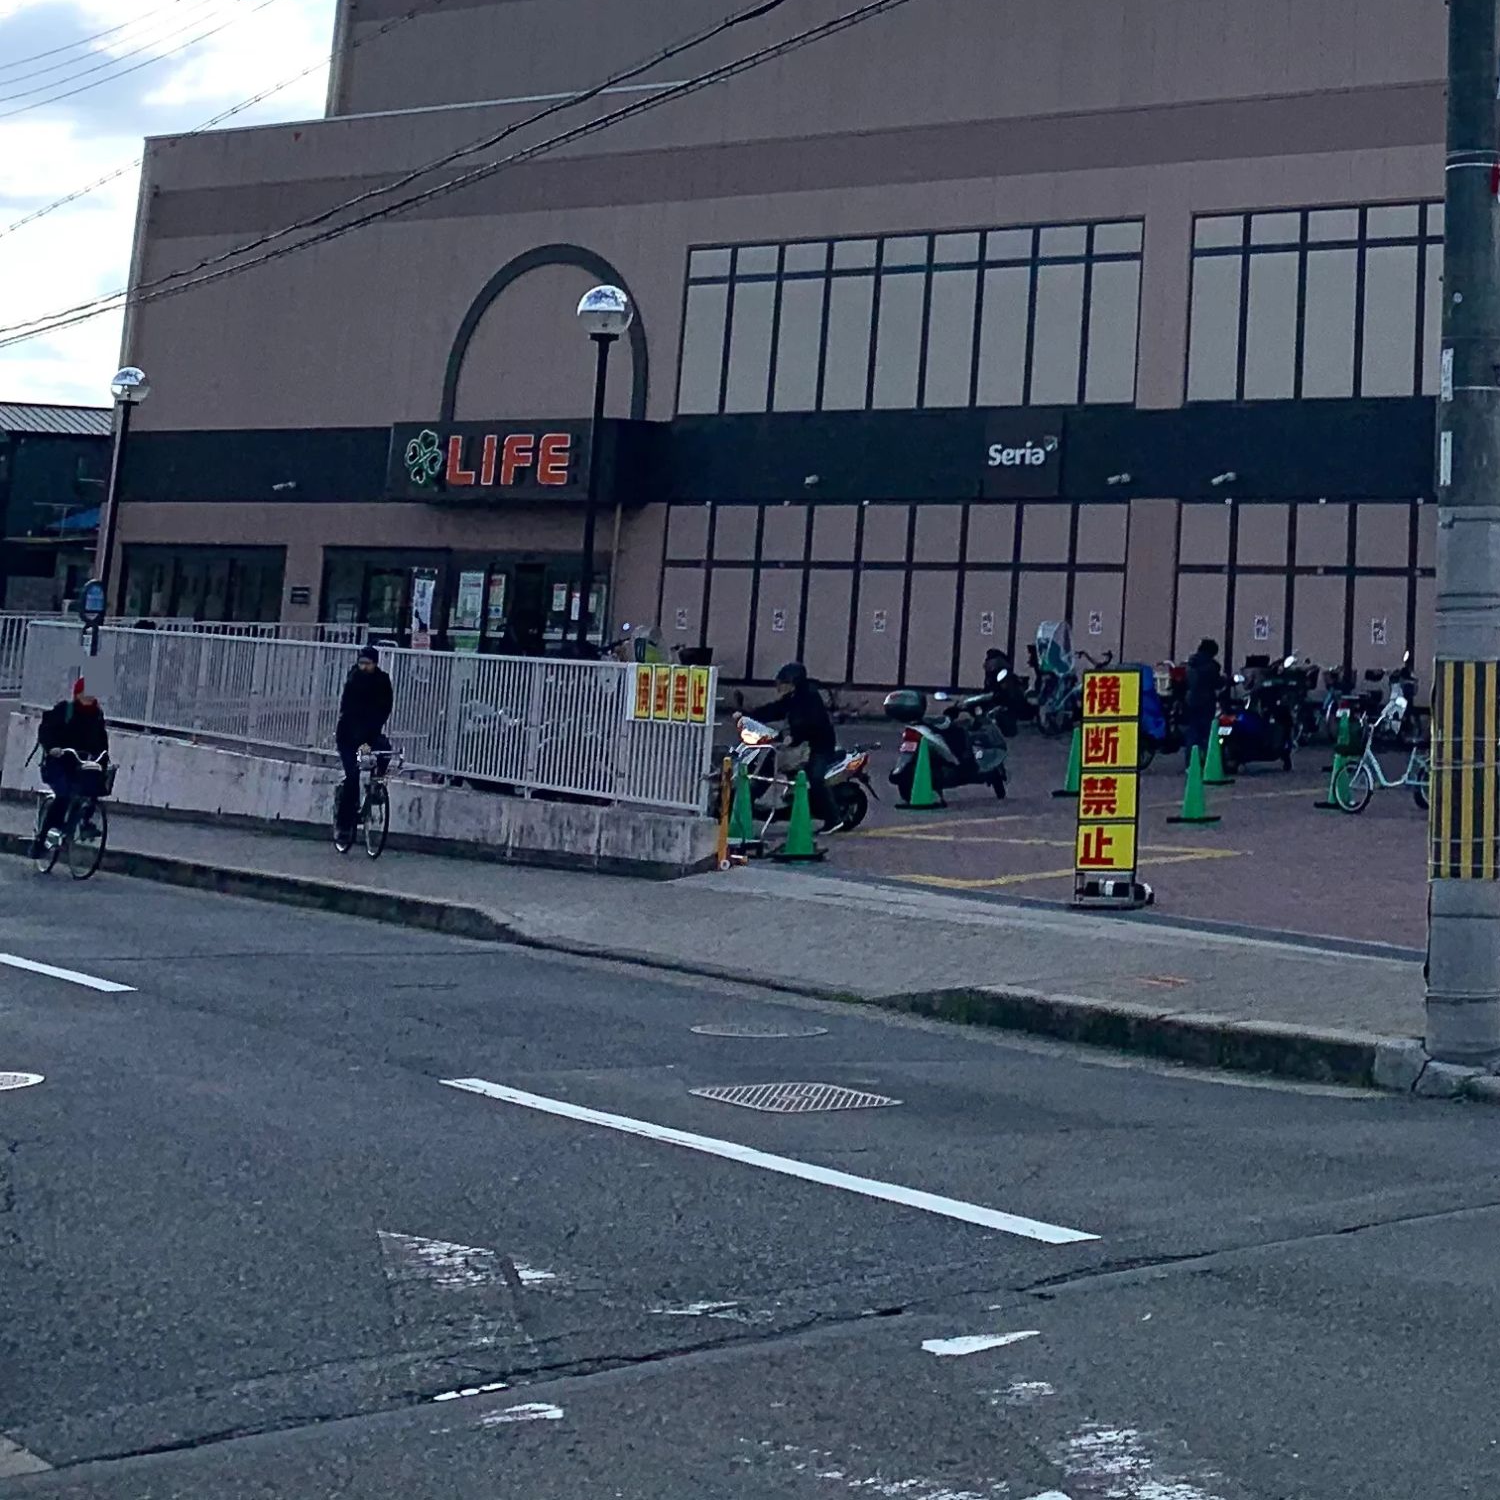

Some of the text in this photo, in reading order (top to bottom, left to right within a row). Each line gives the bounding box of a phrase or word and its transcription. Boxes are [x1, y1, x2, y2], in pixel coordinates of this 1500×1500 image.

[446, 433, 571, 486] LIFE
[988, 440, 1045, 467] Seria
[1079, 675, 1121, 867] 横断禁止
